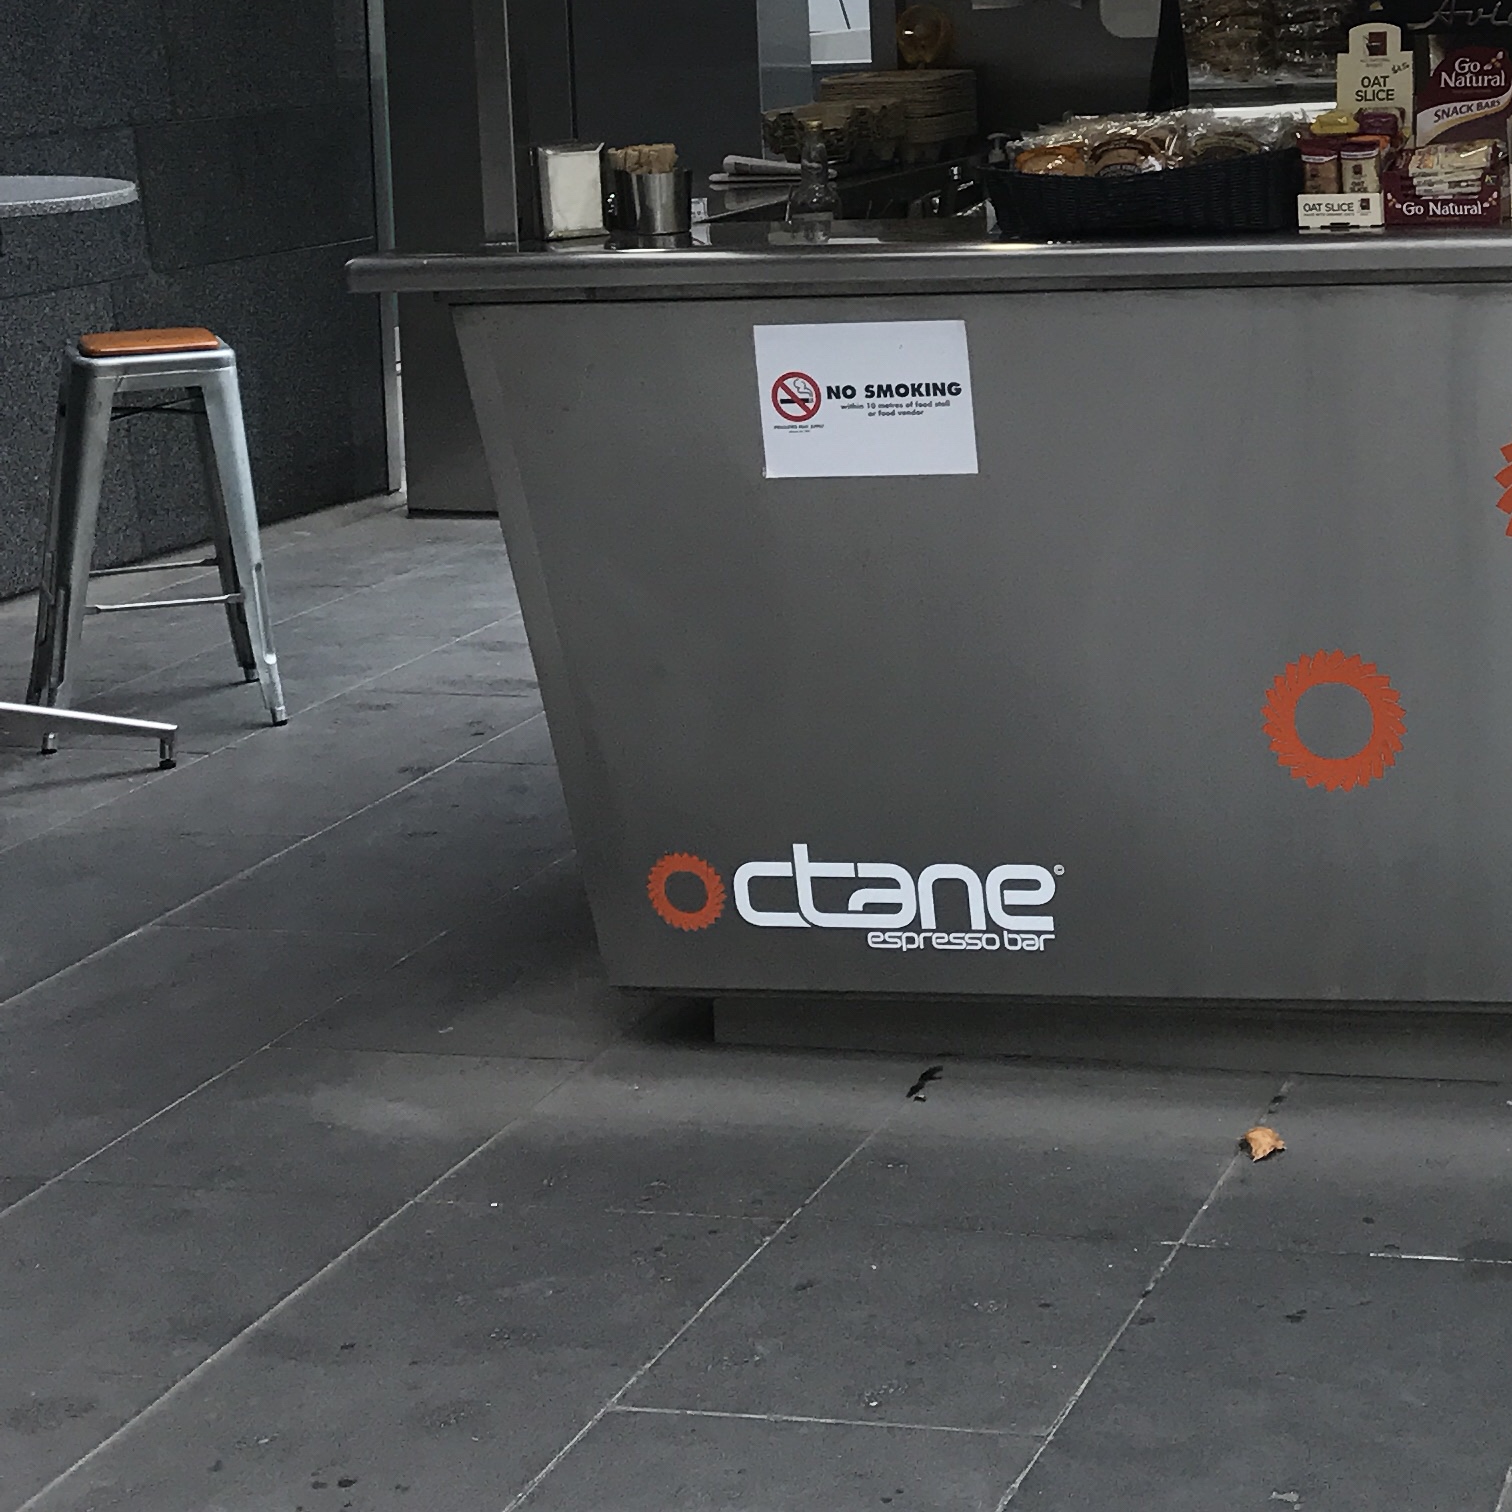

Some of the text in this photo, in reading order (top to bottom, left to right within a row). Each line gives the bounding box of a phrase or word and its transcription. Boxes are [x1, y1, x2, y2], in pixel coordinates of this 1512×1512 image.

[1454, 57, 1481, 74] Go
[1361, 75, 1390, 88] OAT
[1440, 69, 1506, 88] Natural
[1355, 90, 1395, 102] SLICE
[1433, 98, 1501, 123] SNACK BARS
[1303, 202, 1354, 213] OAT SLICE
[1403, 201, 1483, 216] Go Natural
[826, 382, 962, 400] NO SMOKING
[878, 402, 903, 410] metres
[898, 409, 924, 417] vendor
[867, 931, 1056, 952] espresso bar
